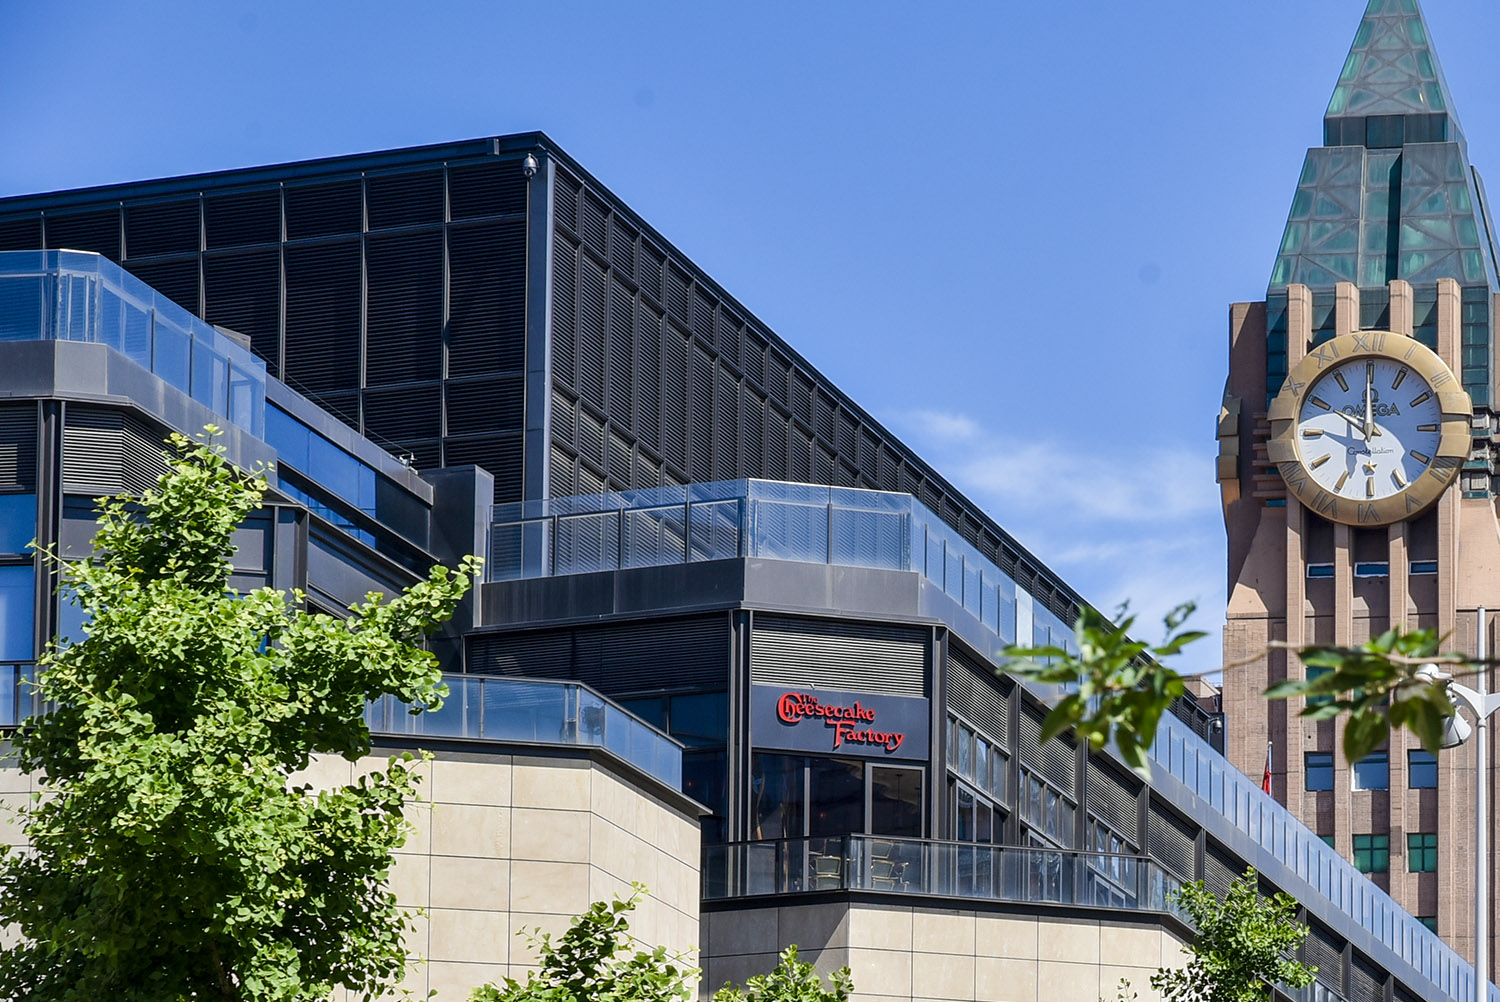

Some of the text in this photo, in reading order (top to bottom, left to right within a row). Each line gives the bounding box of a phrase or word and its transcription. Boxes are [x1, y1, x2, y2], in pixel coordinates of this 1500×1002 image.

[1352, 333, 1386, 352] XII
[1404, 344, 1416, 360] I
[1310, 341, 1340, 368] XI
[1282, 376, 1305, 397] X
[1431, 371, 1451, 387] II
[1342, 402, 1401, 417] OMEGA
[777, 692, 876, 723] Cheesecake
[801, 694, 819, 704] The
[826, 719, 905, 750] Factory
